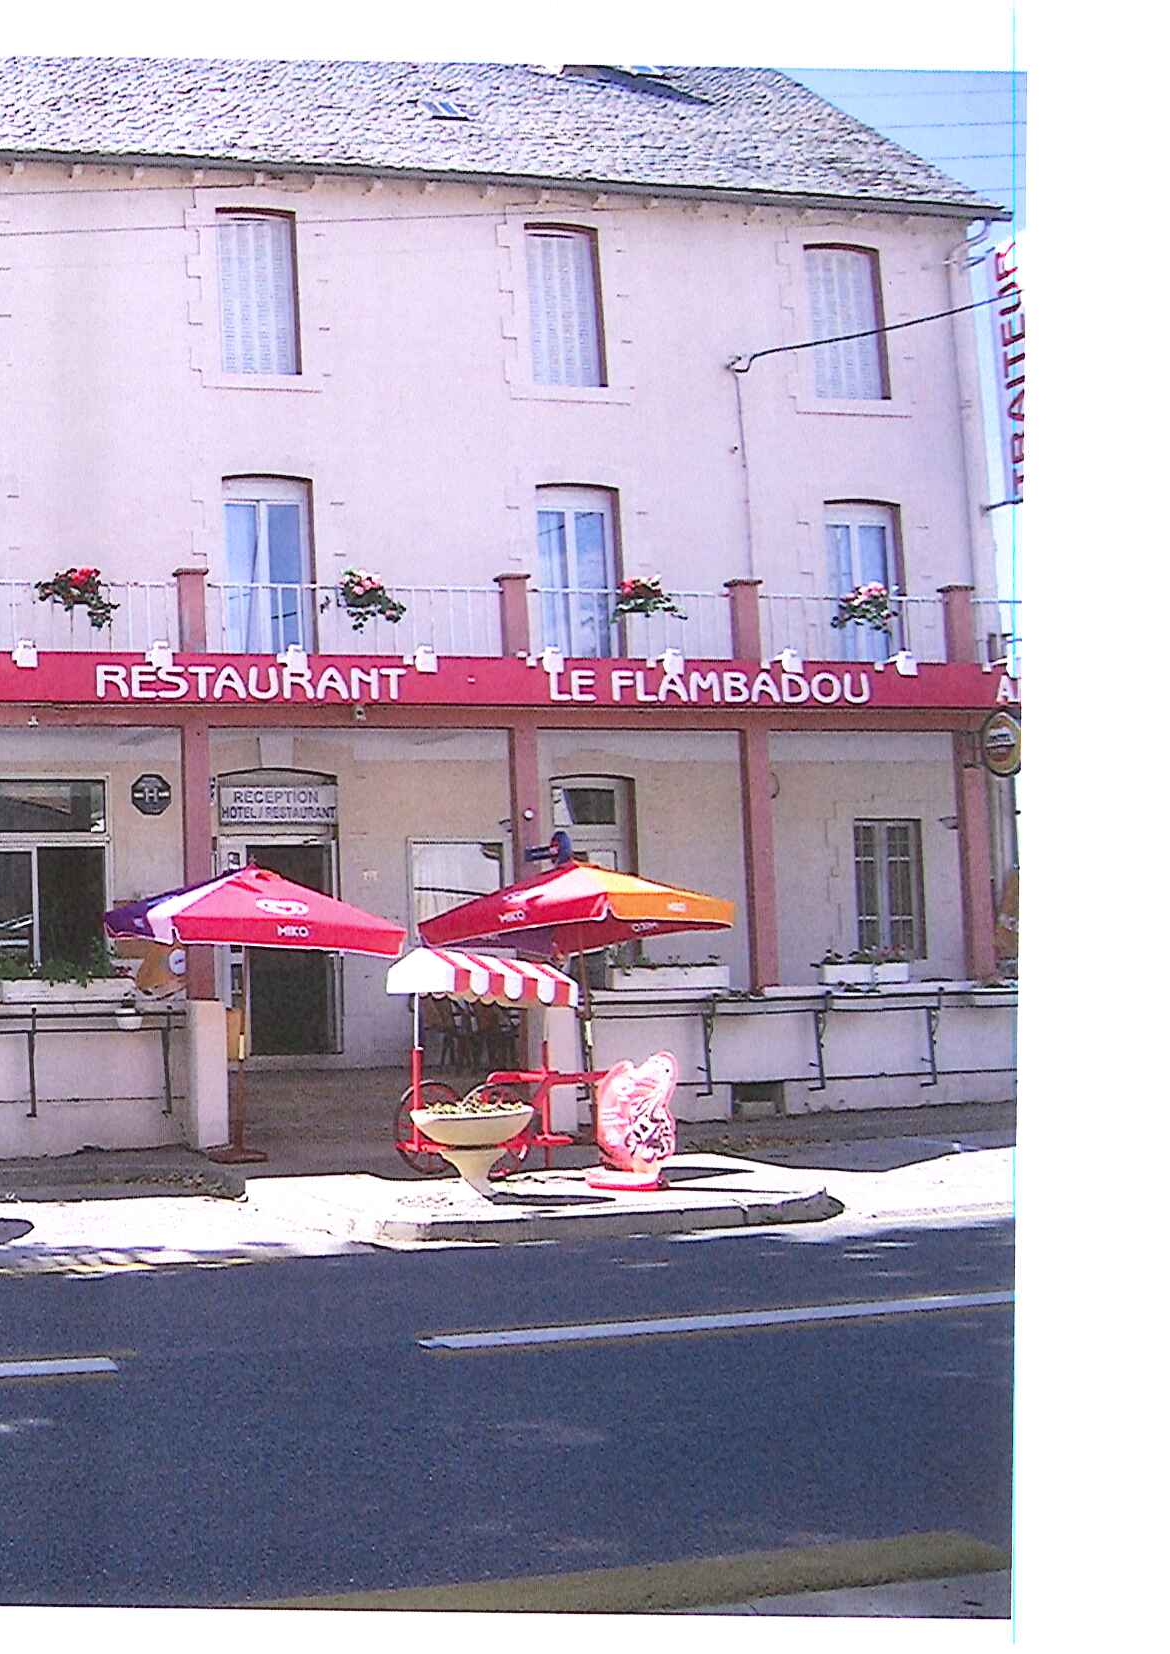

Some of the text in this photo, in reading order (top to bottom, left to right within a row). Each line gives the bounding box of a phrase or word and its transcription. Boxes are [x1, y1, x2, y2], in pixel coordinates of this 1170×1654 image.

[95, 665, 407, 699] RESTAURANT
[549, 669, 596, 702] LE
[611, 670, 871, 704] FLAMBADOU
[233, 790, 319, 803] RECEPTION
[277, 925, 310, 938] MIKO
